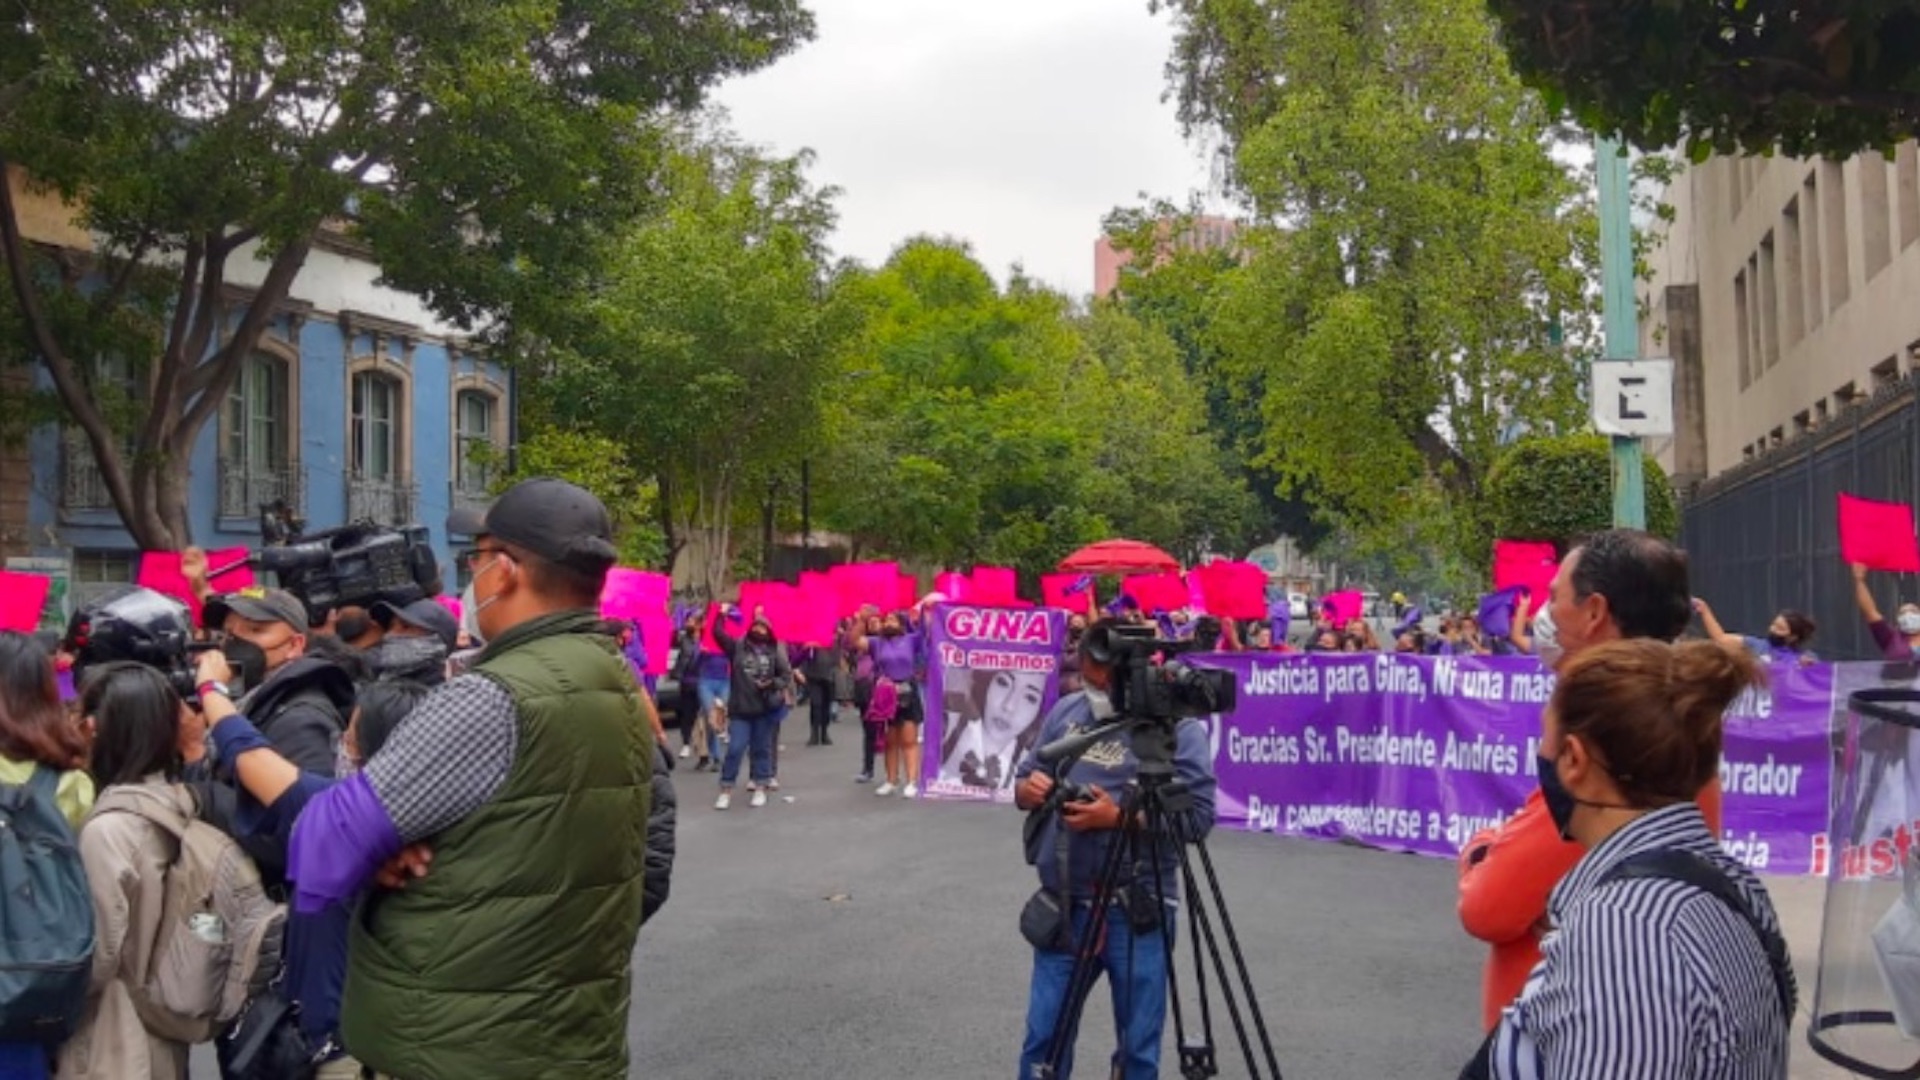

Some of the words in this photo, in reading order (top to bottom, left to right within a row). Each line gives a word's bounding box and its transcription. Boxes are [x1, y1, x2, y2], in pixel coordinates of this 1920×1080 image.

[947, 607, 1051, 644] GINA
[941, 643, 965, 667] Te
[968, 650, 1055, 671] amamos
[1244, 658, 1320, 695] Justicia
[1326, 664, 1370, 702] para
[1375, 654, 1428, 702] Gina,
[1433, 656, 1457, 696] Ni
[1461, 670, 1504, 700] una
[1229, 726, 1300, 763] Gracias
[1304, 725, 1332, 763] Sr.
[1336, 725, 1437, 768] Presidente
[1442, 731, 1519, 775] Andrés
[1718, 753, 1802, 796] brador
[1248, 795, 1280, 831] Por
[1427, 811, 1440, 841] a
